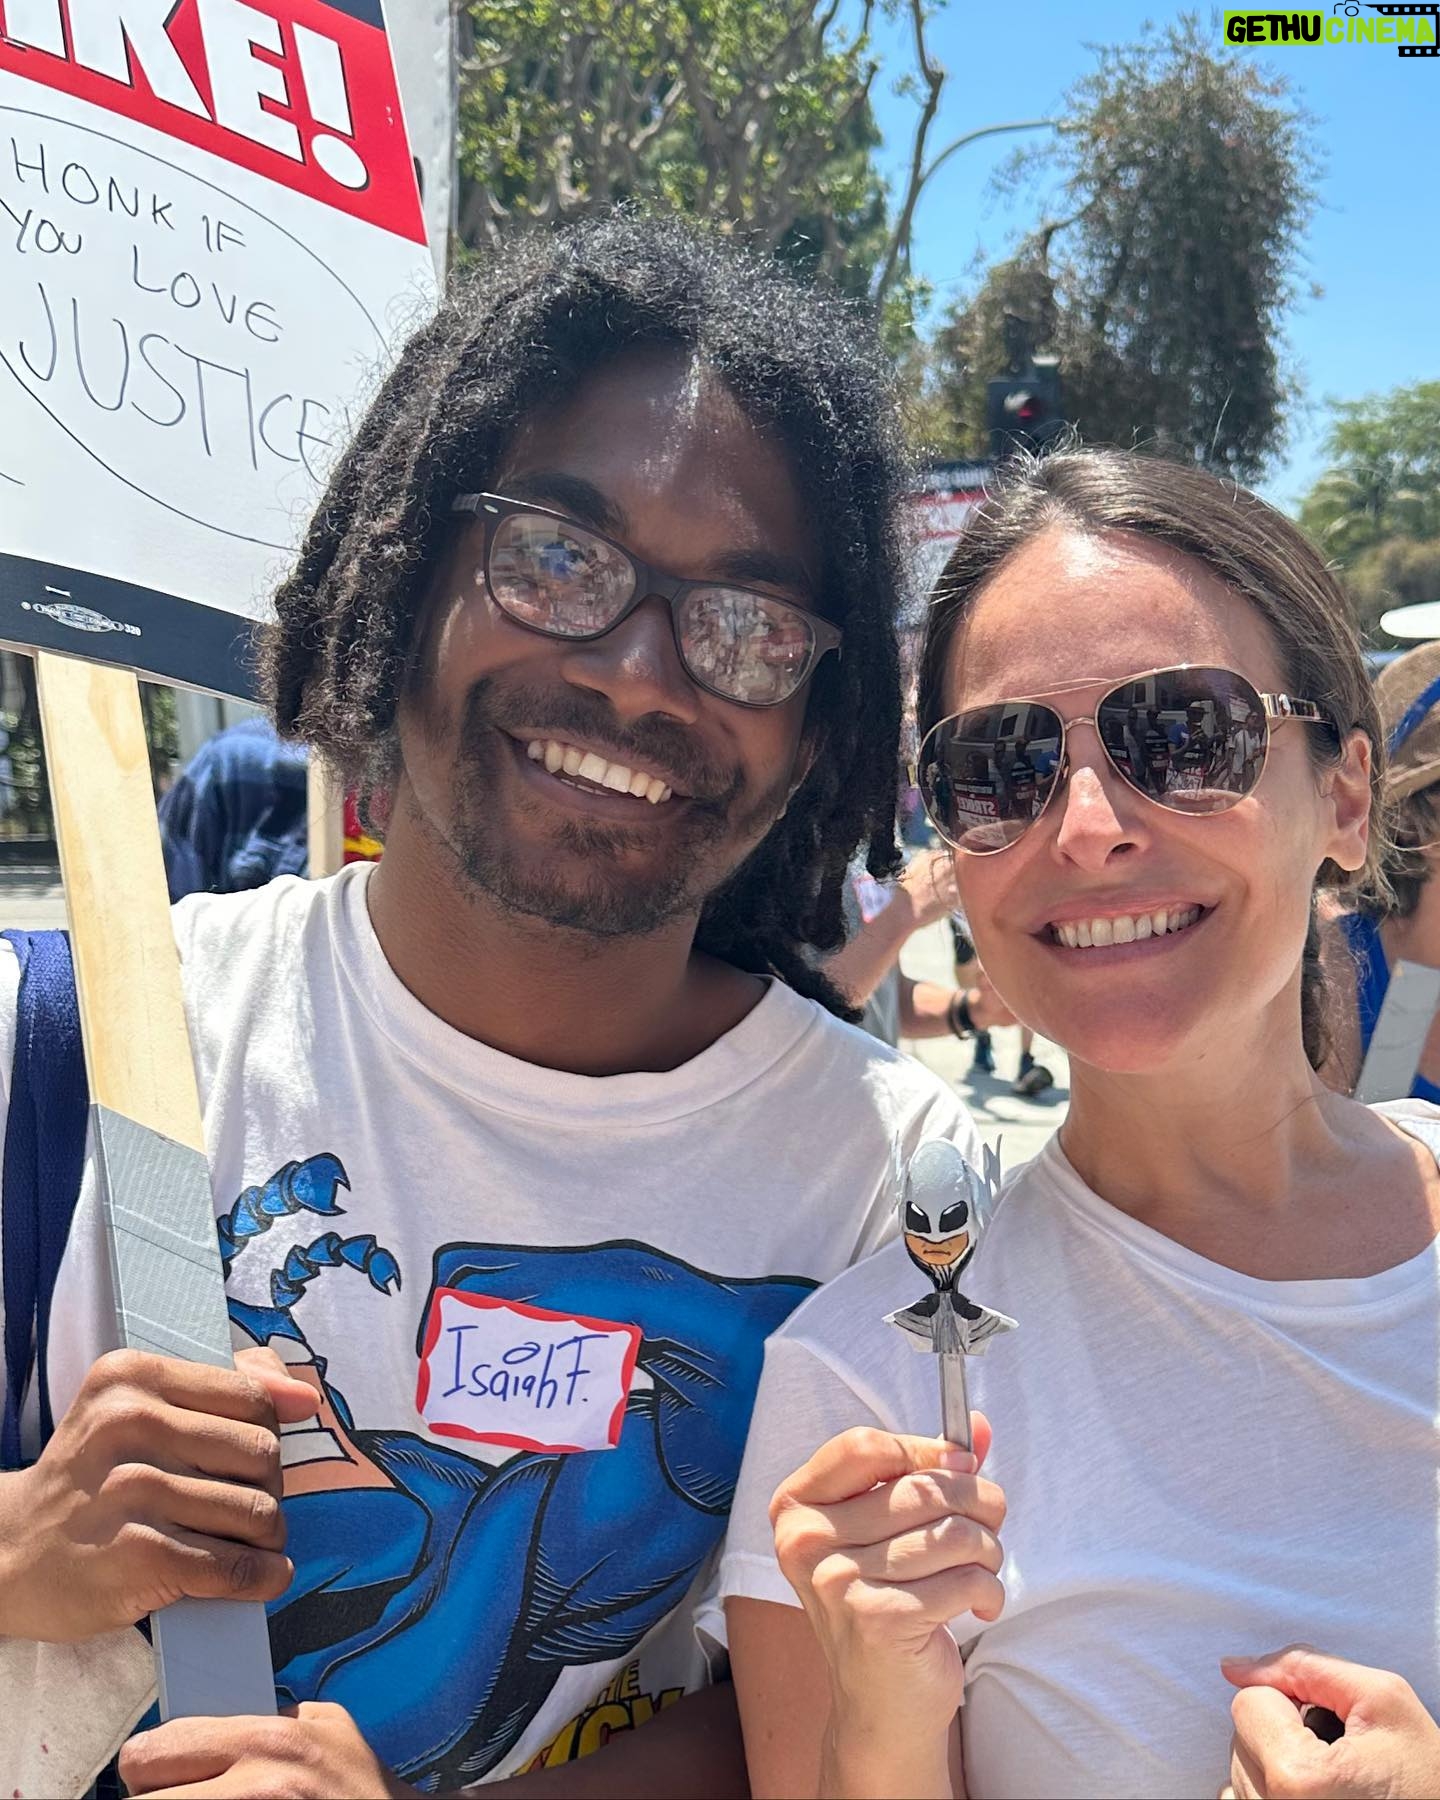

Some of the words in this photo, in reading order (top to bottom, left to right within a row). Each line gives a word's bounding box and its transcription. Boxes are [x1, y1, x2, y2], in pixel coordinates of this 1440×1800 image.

[11, 137, 175, 231] HONK
[202, 215, 247, 252] IF
[0, 199, 82, 254] YOU
[133, 245, 283, 342] LOVE
